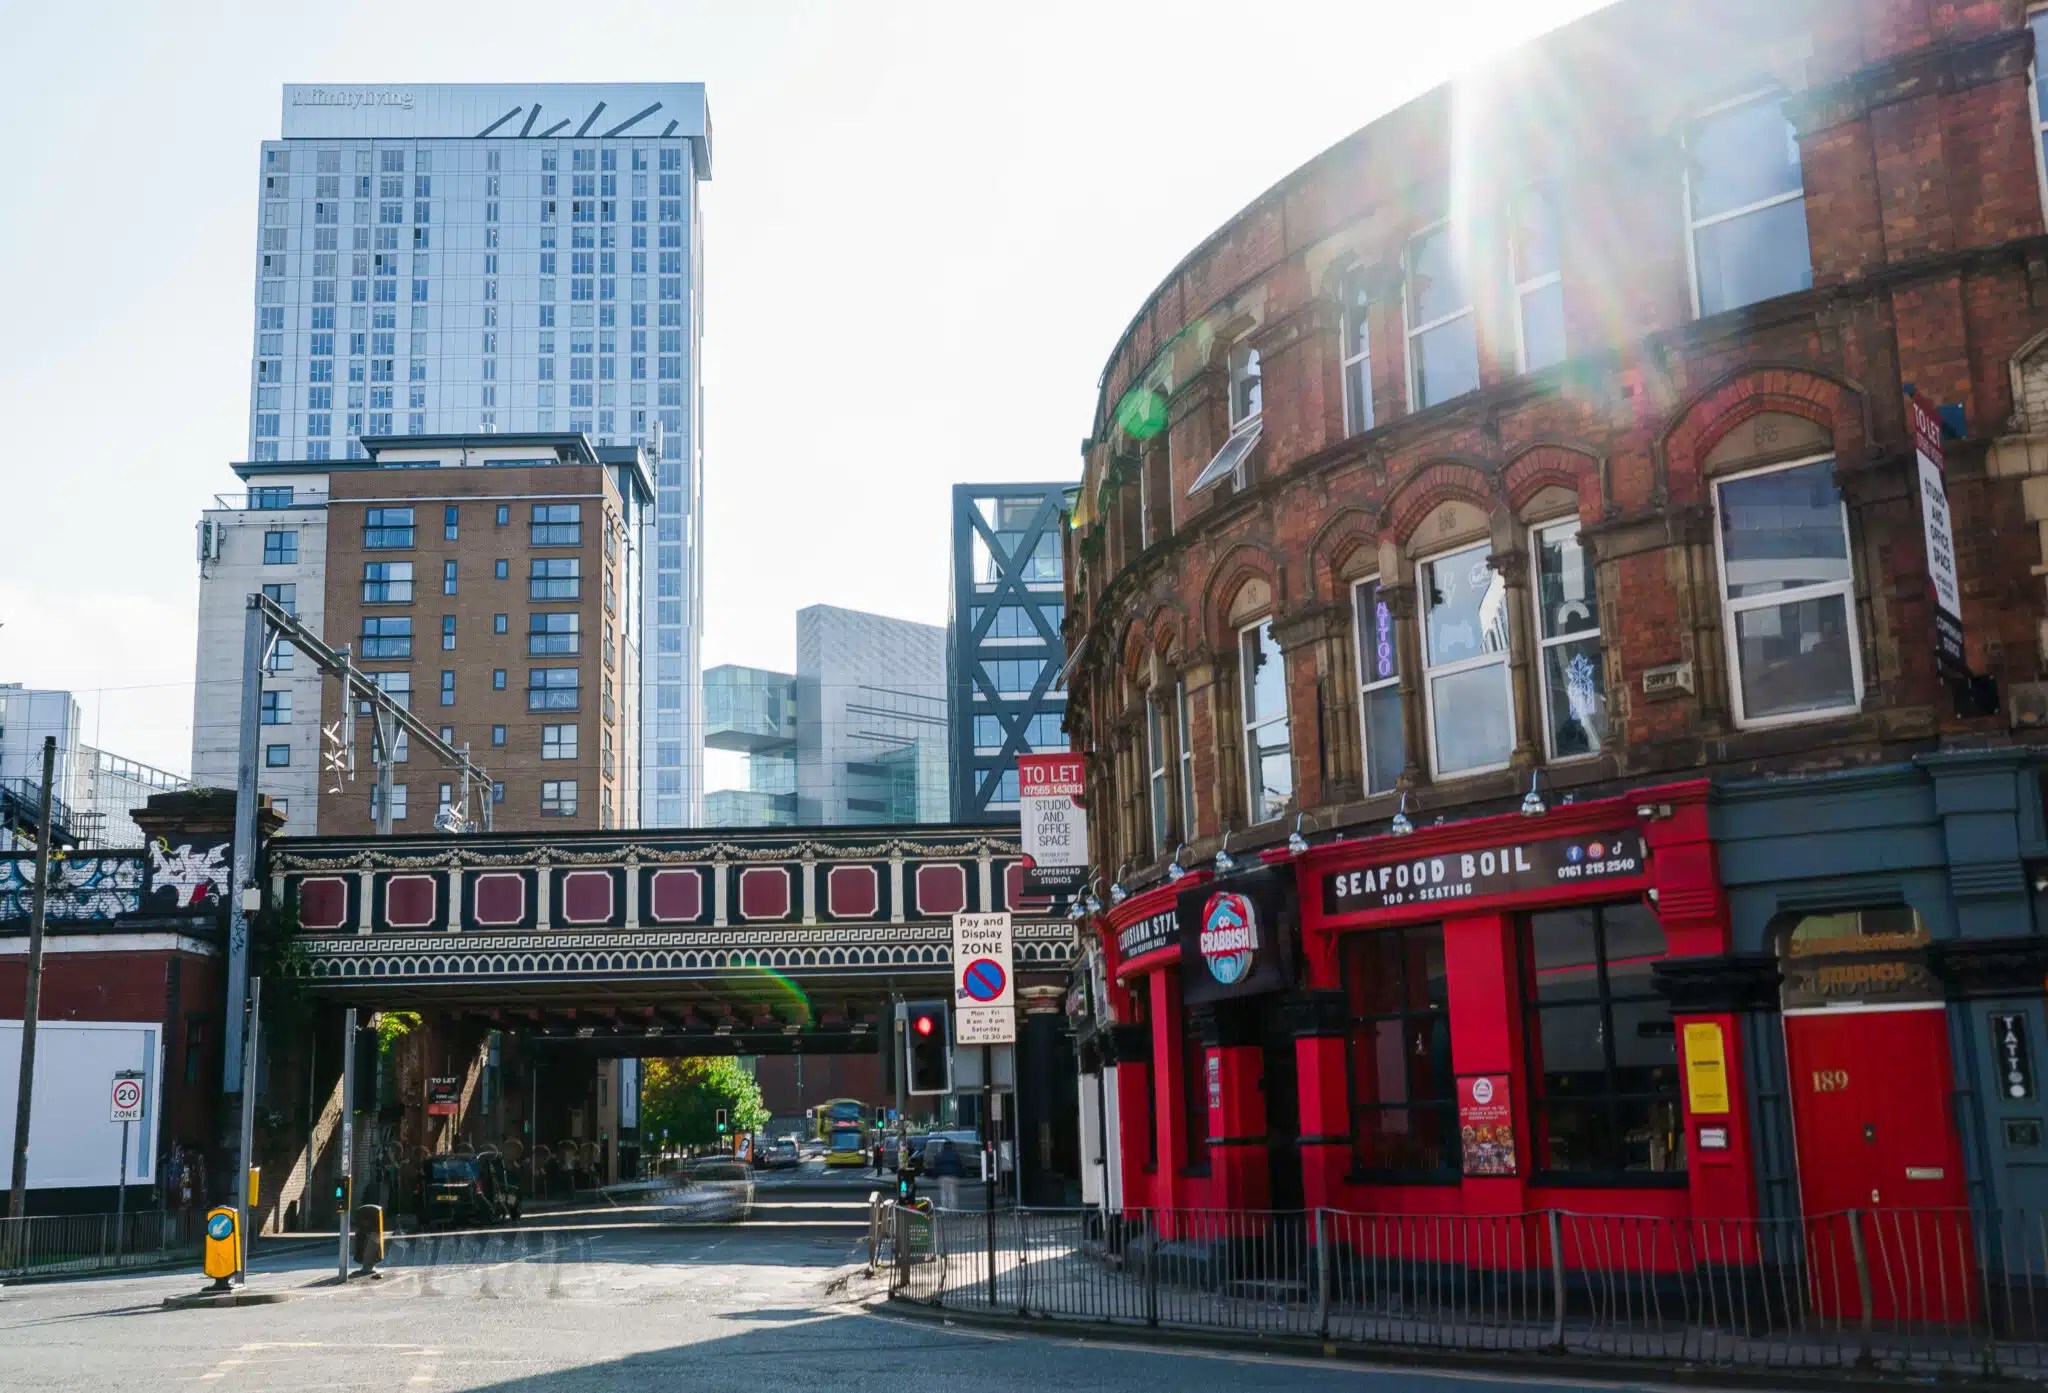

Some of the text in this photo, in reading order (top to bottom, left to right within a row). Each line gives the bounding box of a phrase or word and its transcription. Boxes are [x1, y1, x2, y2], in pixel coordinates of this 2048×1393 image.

[1912, 402, 1926, 434] TO
[1926, 419, 1941, 448] LET
[1375, 584, 1391, 676] ATTOO
[1023, 764, 1080, 783] TO LET
[1035, 800, 1071, 811] STUDIO
[1043, 812, 1064, 822] AND
[1038, 823, 1071, 834] OFFICE
[1039, 835, 1071, 847] SPACE
[1031, 867, 1081, 877] COPPERHEAD
[1335, 846, 1531, 897] SEAFOOD BOIL
[1557, 858, 1635, 878] 0161 215 2540
[1040, 876, 1072, 885] STUDIOS
[1382, 892, 1403, 906] 100
[1420, 883, 1473, 900] SEATING
[960, 916, 1003, 928] Pay and
[962, 928, 1002, 939] Display
[1200, 927, 1250, 953] CRABBISH
[962, 942, 1003, 954] ZONE
[2003, 1015, 2026, 1099] TATTOO
[1812, 1070, 1849, 1092] 189
[118, 1089, 137, 1101] 20
[113, 1110, 138, 1118] ZONE
